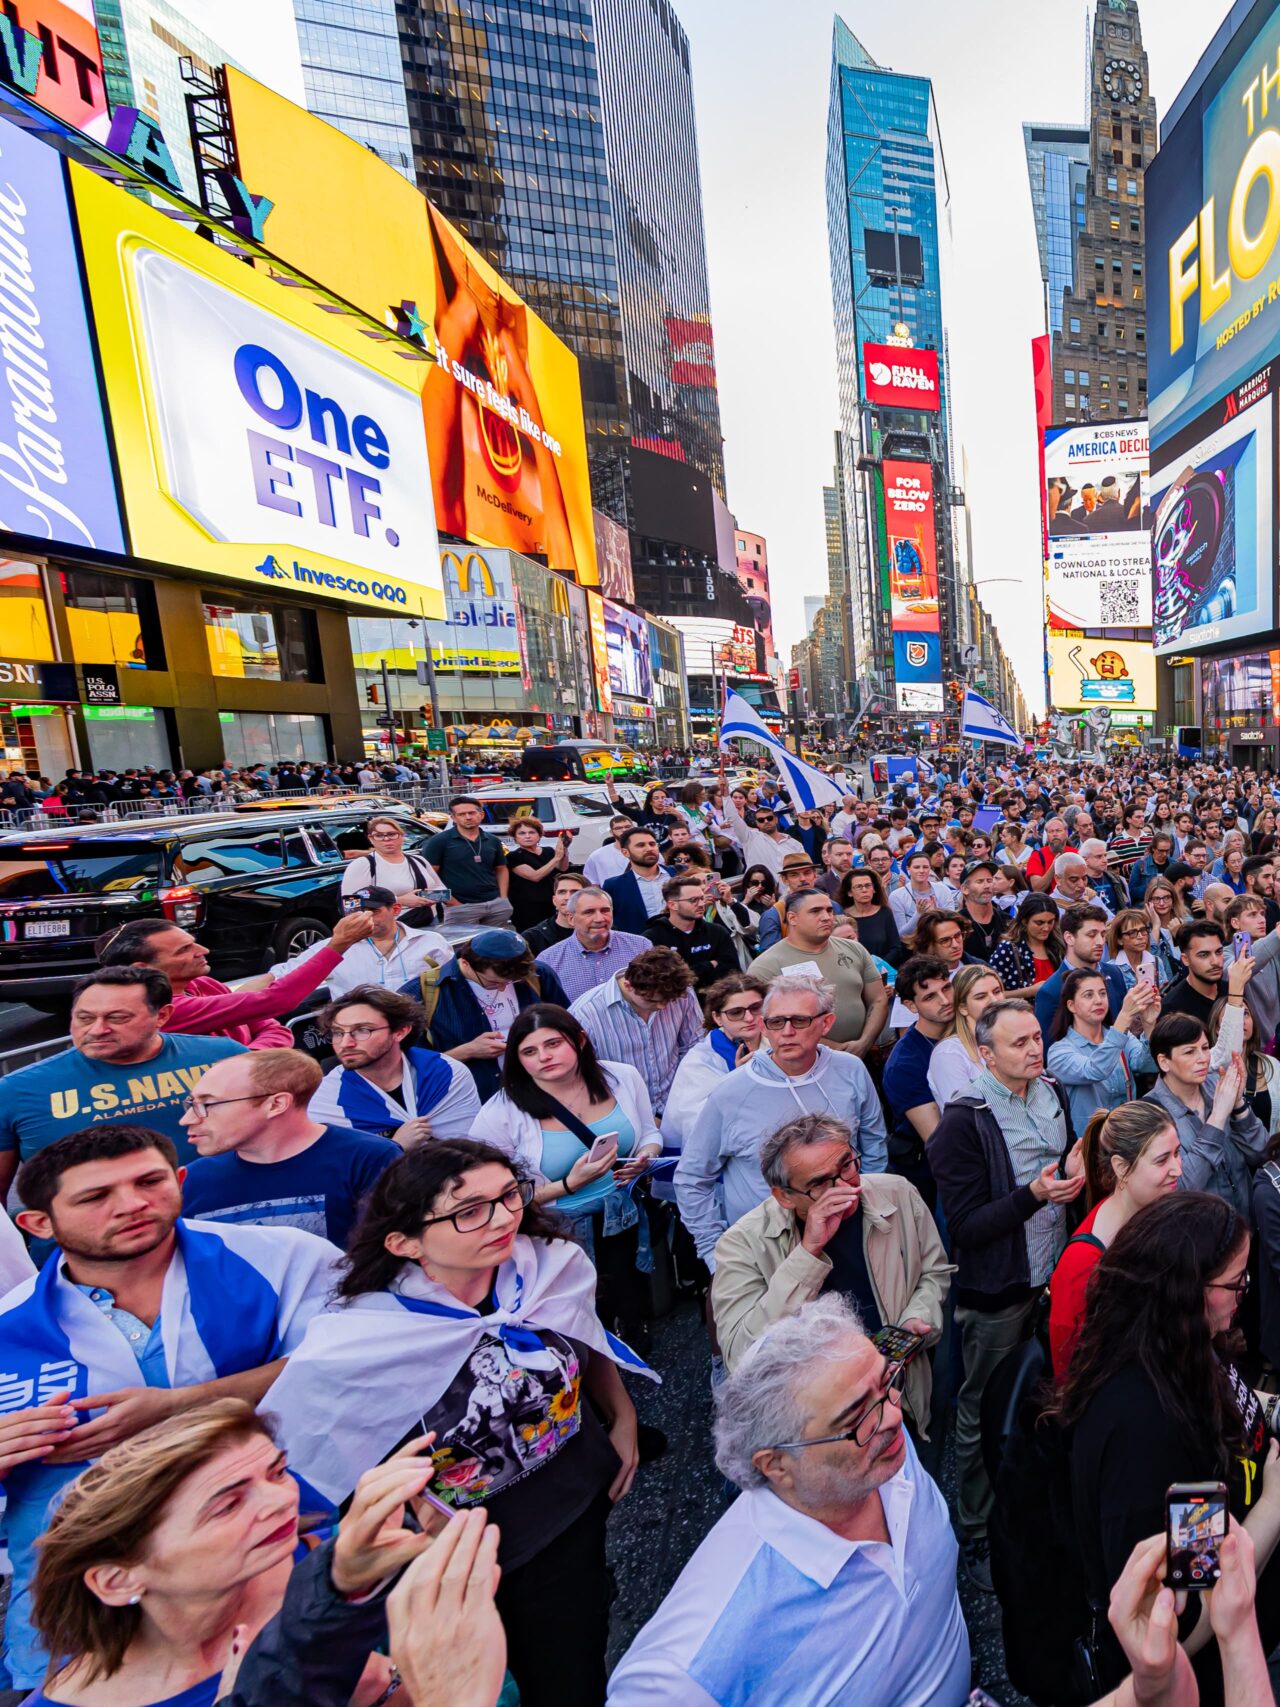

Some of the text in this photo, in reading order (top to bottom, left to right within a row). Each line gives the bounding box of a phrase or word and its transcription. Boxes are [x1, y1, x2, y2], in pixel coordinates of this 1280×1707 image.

[1216, 307, 1251, 350] HOSTED
[1252, 297, 1265, 319] BY
[1239, 366, 1271, 397] MARRIOTT
[434, 338, 561, 457] it sure feels like one
[1239, 382, 1267, 409] MARQUIS
[233, 343, 390, 470] One
[1100, 428, 1138, 438] CBS NEWS
[1068, 440, 1117, 457] AMERICA
[246, 428, 399, 548] ETF.
[896, 477, 920, 488] FOR
[887, 488, 929, 501] BELOW
[476, 484, 532, 526] McDelivery
[893, 500, 926, 512] ZERO
[1054, 557, 1151, 570] DOWNLOAD TO STREA
[1063, 567, 1146, 578] NATIONAL & LOCAL
[293, 560, 406, 605] Invesco QQQ
[706, 567, 715, 600] 1500
[87, 677, 106, 685] U.S.
[88, 684, 115, 692] POLO
[88, 690, 118, 699] ASSN.
[27, 924, 67, 935] ELITE888
[92, 1101, 164, 1122] ALAMEDA
